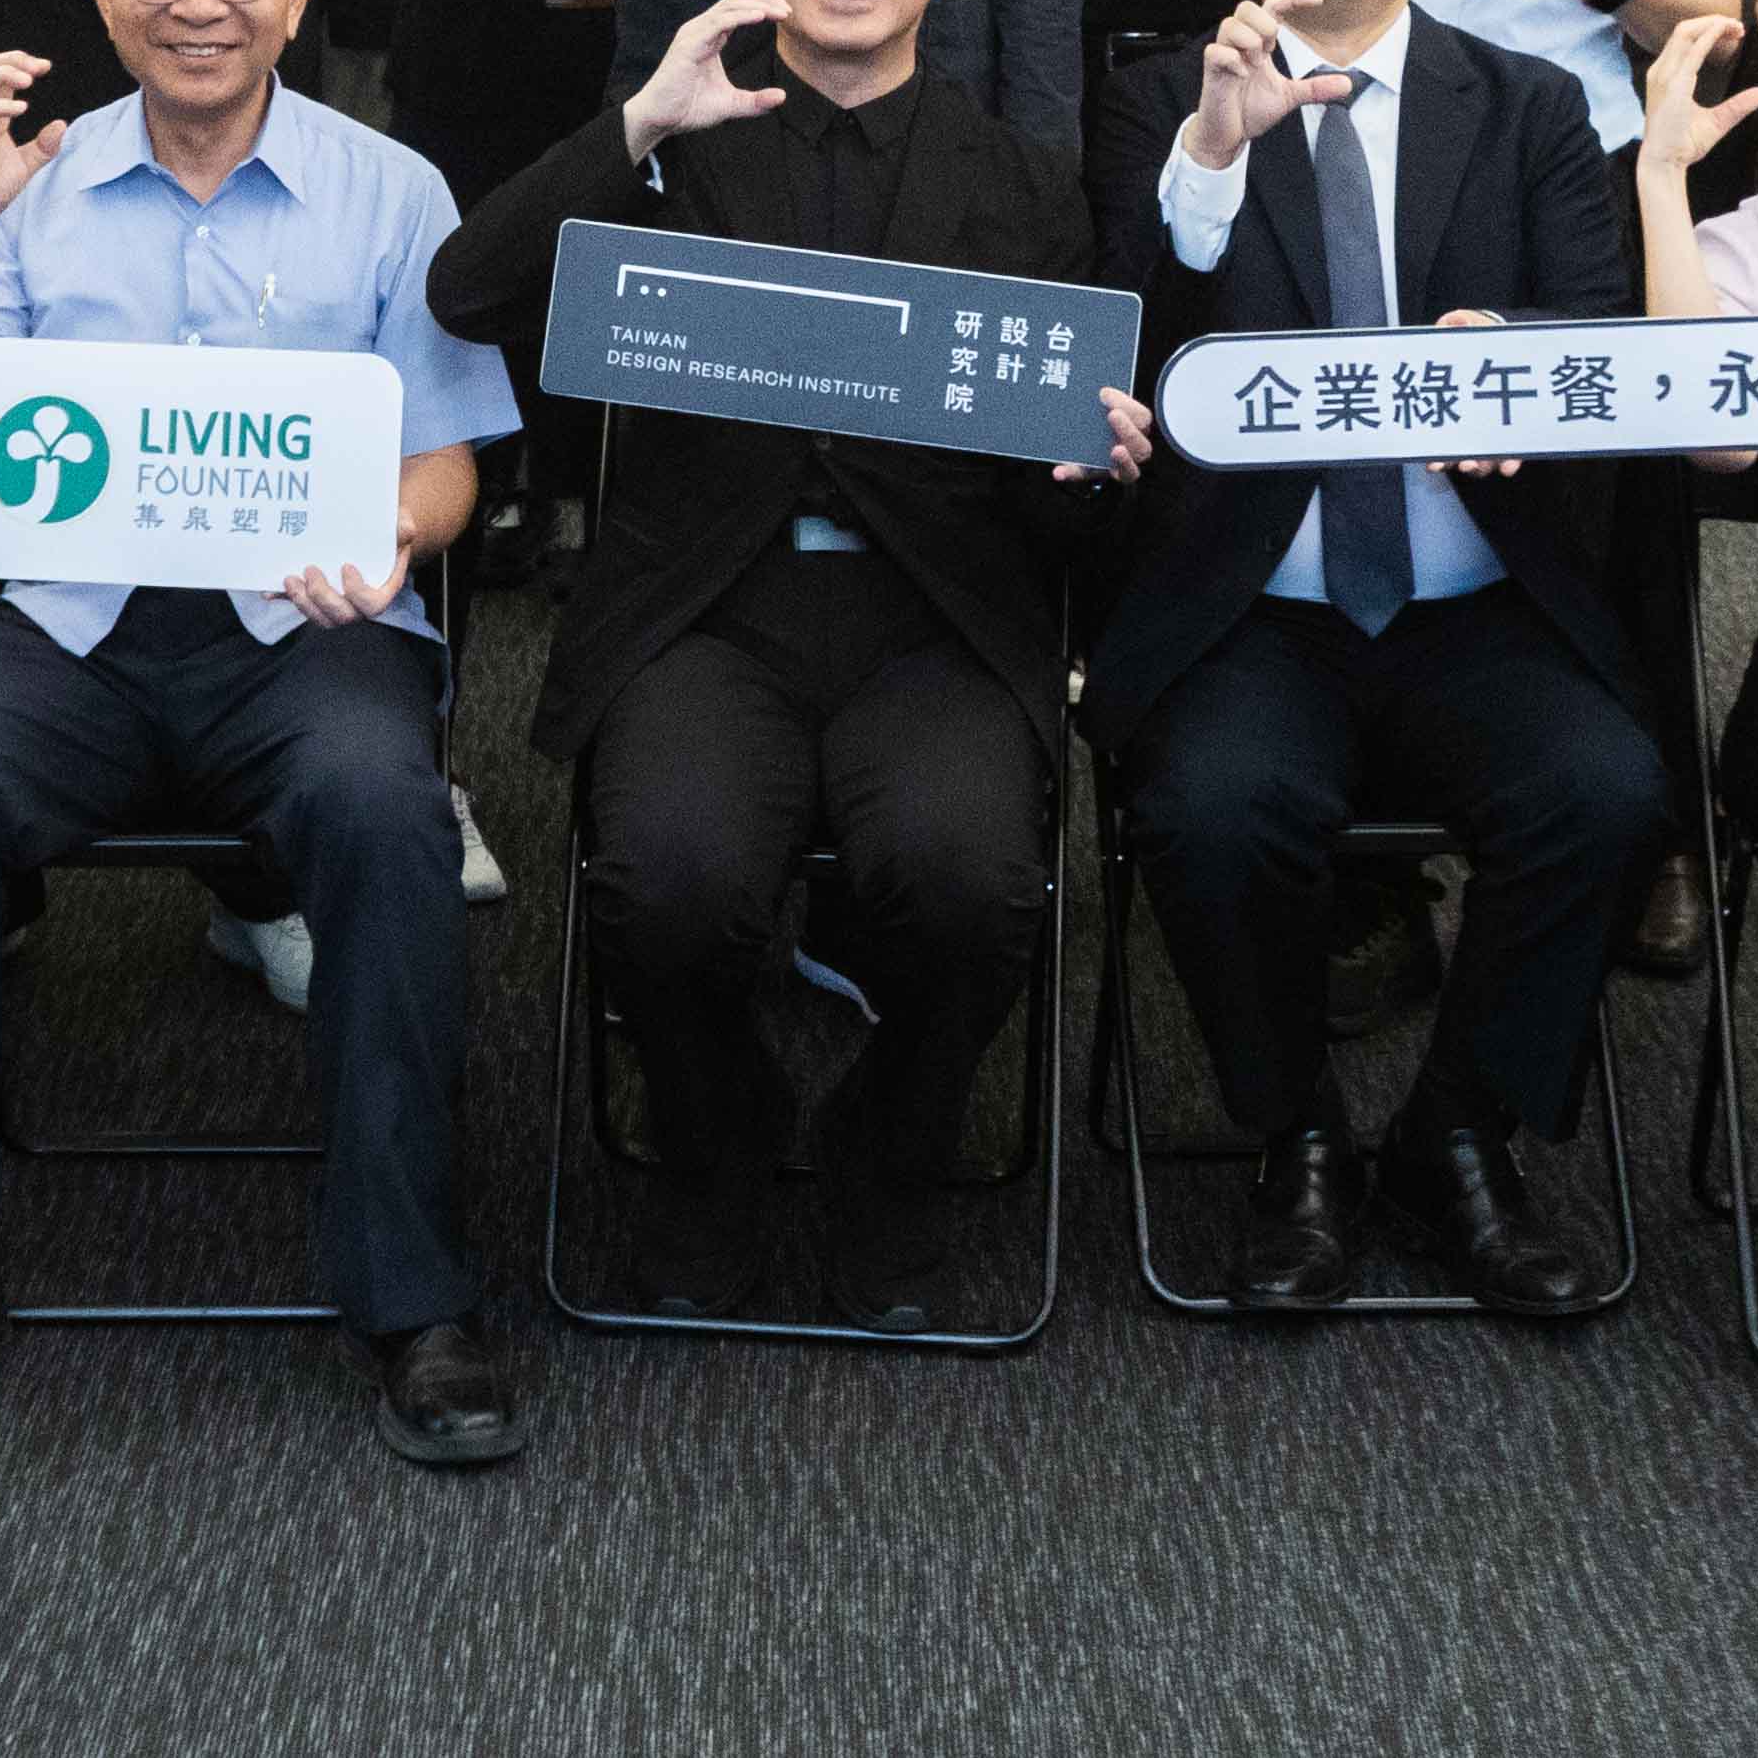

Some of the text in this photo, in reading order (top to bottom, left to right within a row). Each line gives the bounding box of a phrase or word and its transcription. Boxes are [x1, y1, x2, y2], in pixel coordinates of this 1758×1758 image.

[610, 325, 688, 351] TAIWAN
[606, 349, 902, 404] DESIGN RESEARCH INSTITUTE
[139, 407, 313, 462] LIVING
[136, 463, 311, 502] FOUNTAIN
